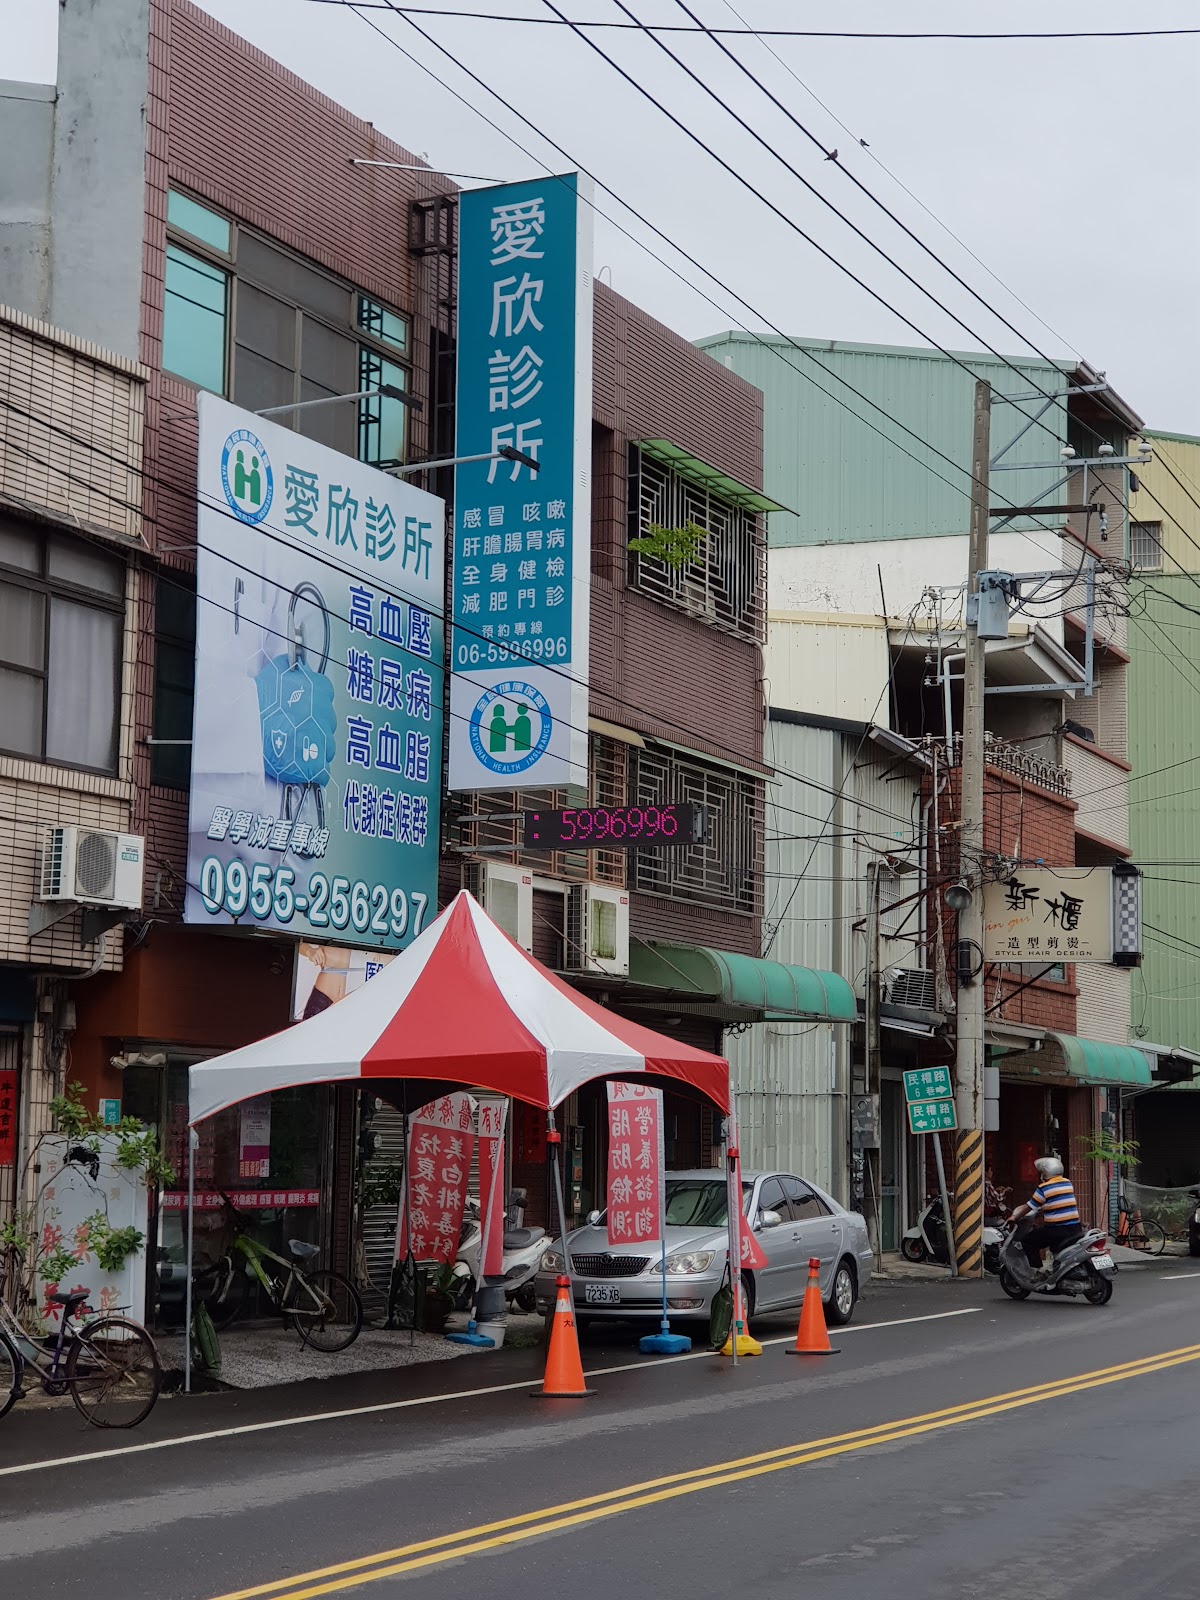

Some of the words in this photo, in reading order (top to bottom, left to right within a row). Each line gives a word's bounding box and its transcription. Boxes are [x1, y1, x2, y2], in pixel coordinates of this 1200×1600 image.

[487, 197, 546, 485] 愛欣診所
[283, 463, 434, 580] 愛欣診所
[463, 505, 506, 530] 感冒
[522, 499, 567, 524] 咳嗽
[462, 528, 567, 558] 肝膽腸胃病
[461, 556, 566, 587] 全身健檢
[461, 585, 566, 615] 減肥門診
[349, 584, 432, 656] 高血壓
[481, 620, 544, 639] 預約專線
[457, 636, 568, 666] 06-5996996
[346, 648, 433, 720] 糖尿病
[346, 715, 431, 783] 高血脂
[492, 762, 521, 773] HEALTH
[343, 780, 428, 847] 代謝症候群
[560, 805, 678, 840] 5996996
[206, 805, 331, 859] 醫學減重專線
[201, 854, 428, 938] 0955-256297
[907, 1070, 946, 1087] 民權路
[913, 1103, 950, 1118] 民權路
